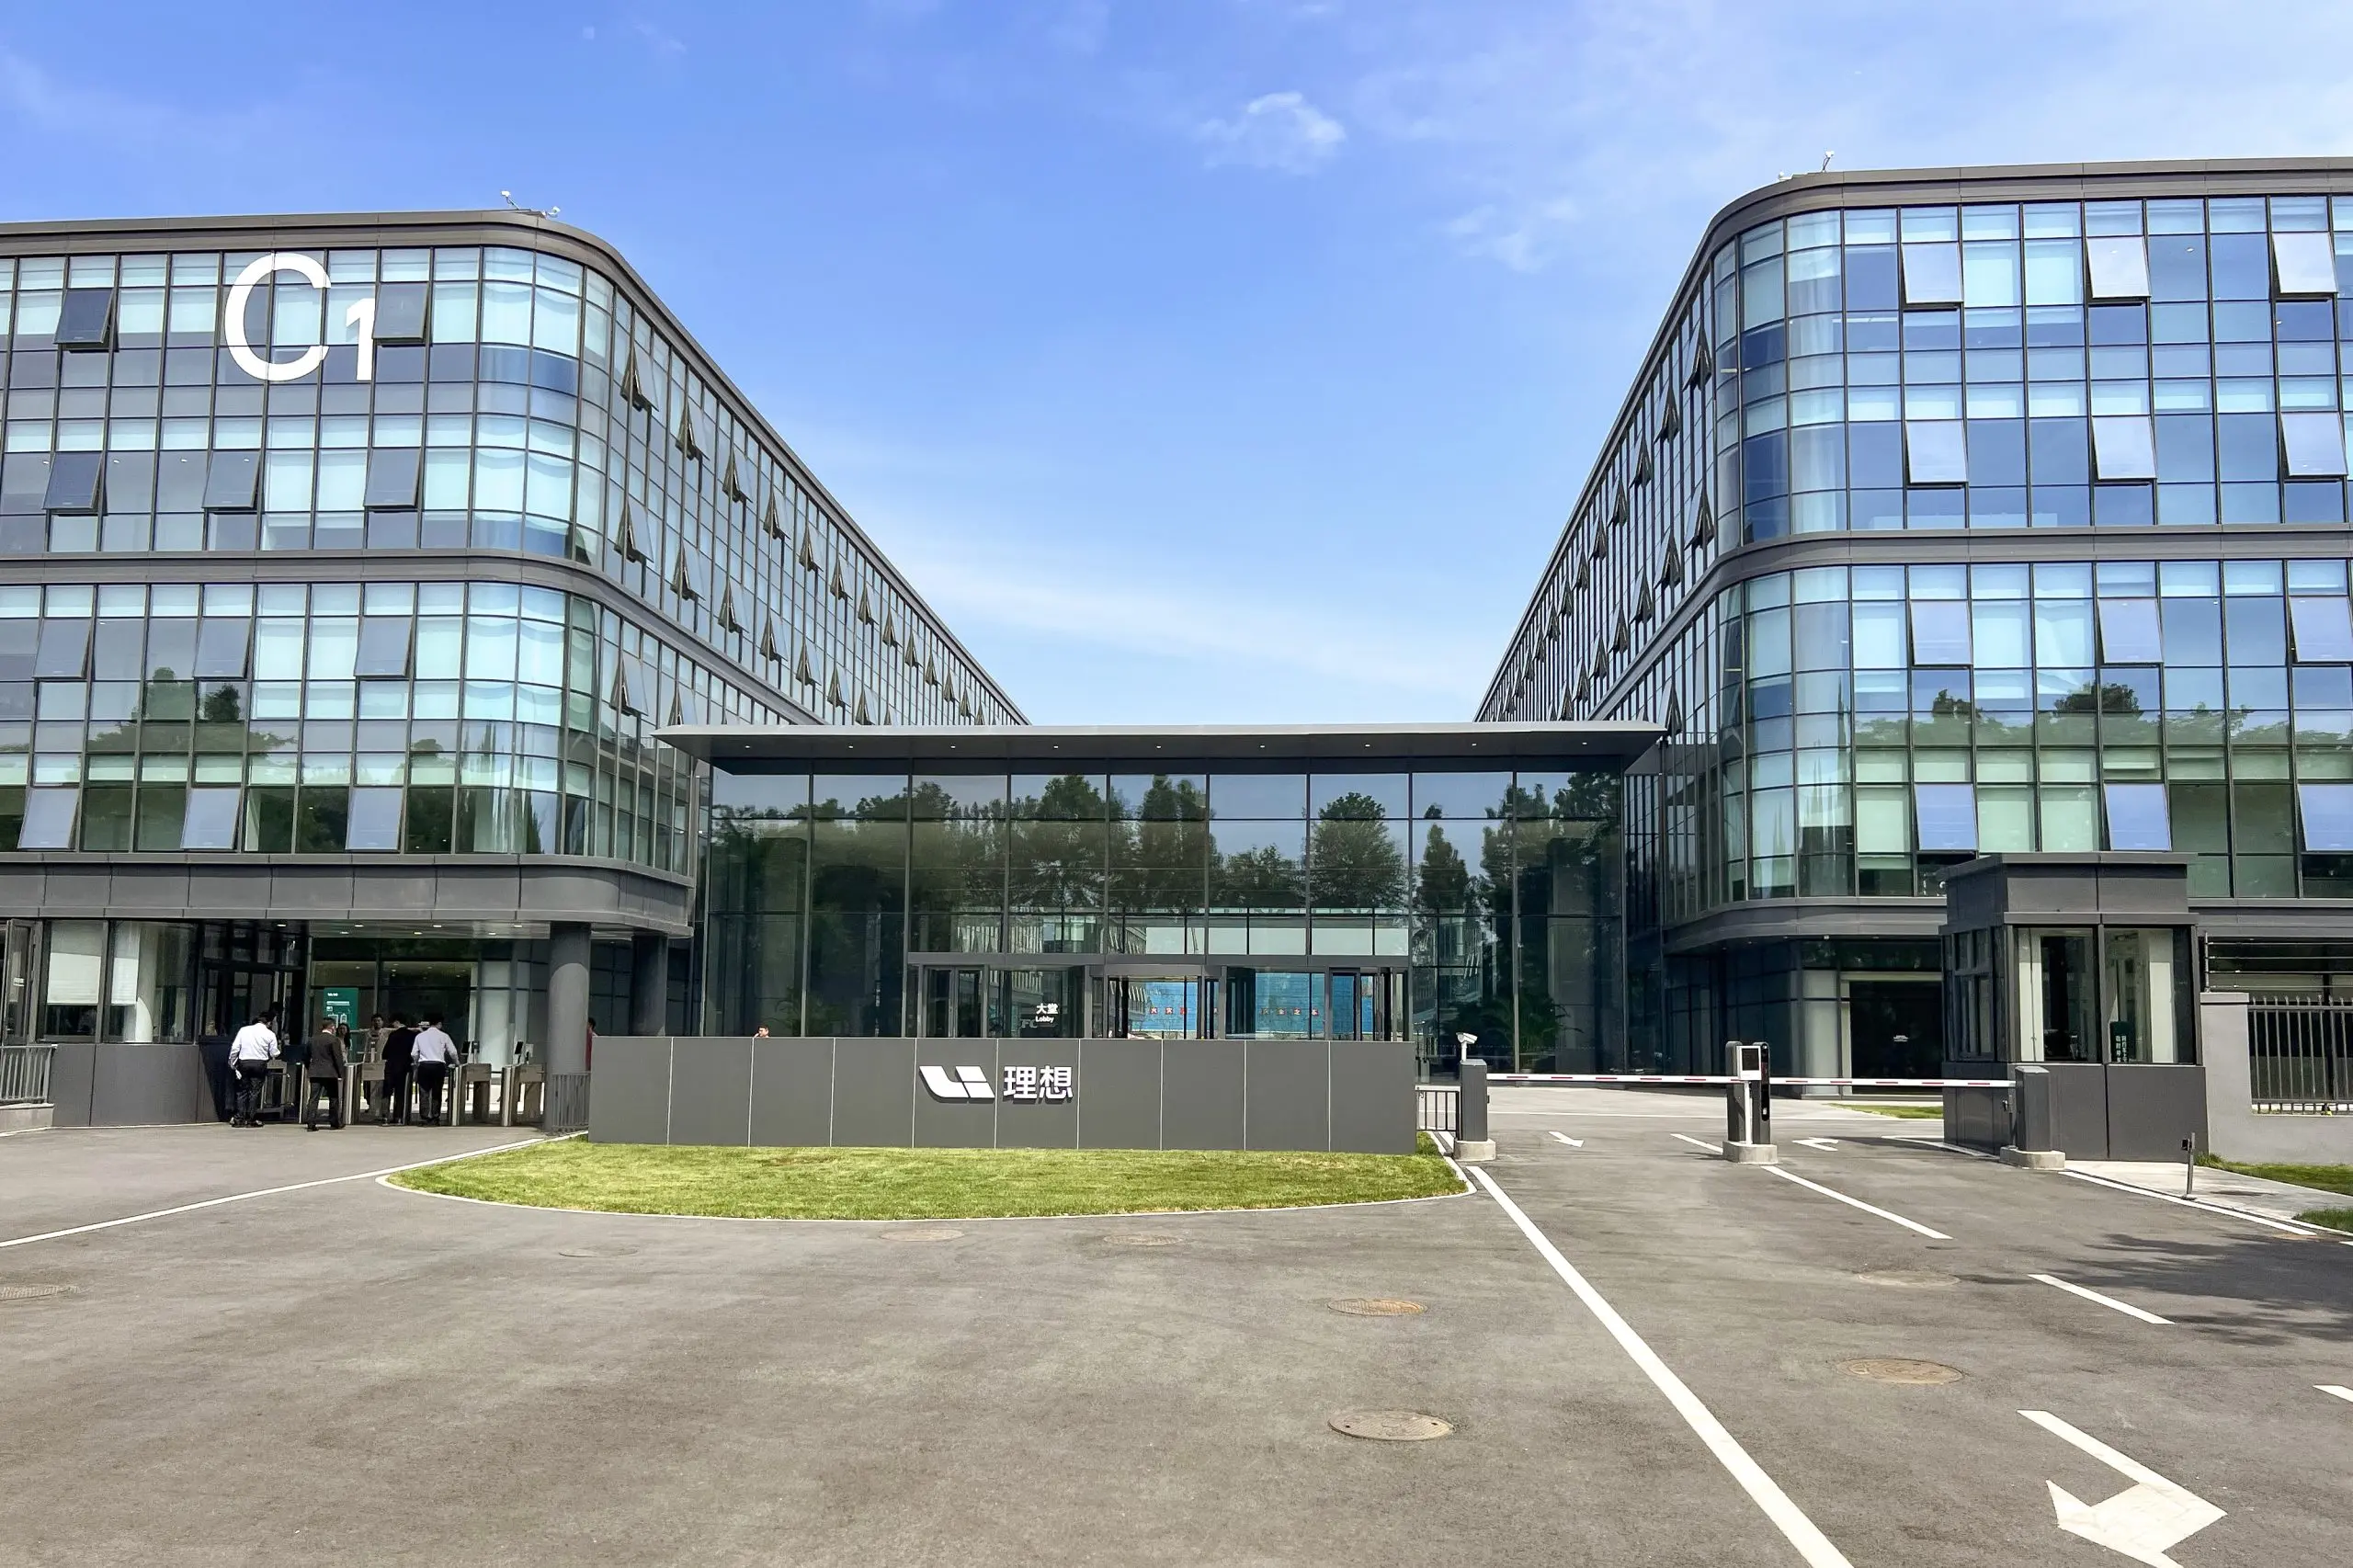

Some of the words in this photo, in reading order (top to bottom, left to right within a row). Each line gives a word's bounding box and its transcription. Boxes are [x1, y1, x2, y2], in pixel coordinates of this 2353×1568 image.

[224, 252, 376, 381] C1
[1036, 1003, 1059, 1015] 大堂
[1003, 1065, 1073, 1100] 理想
